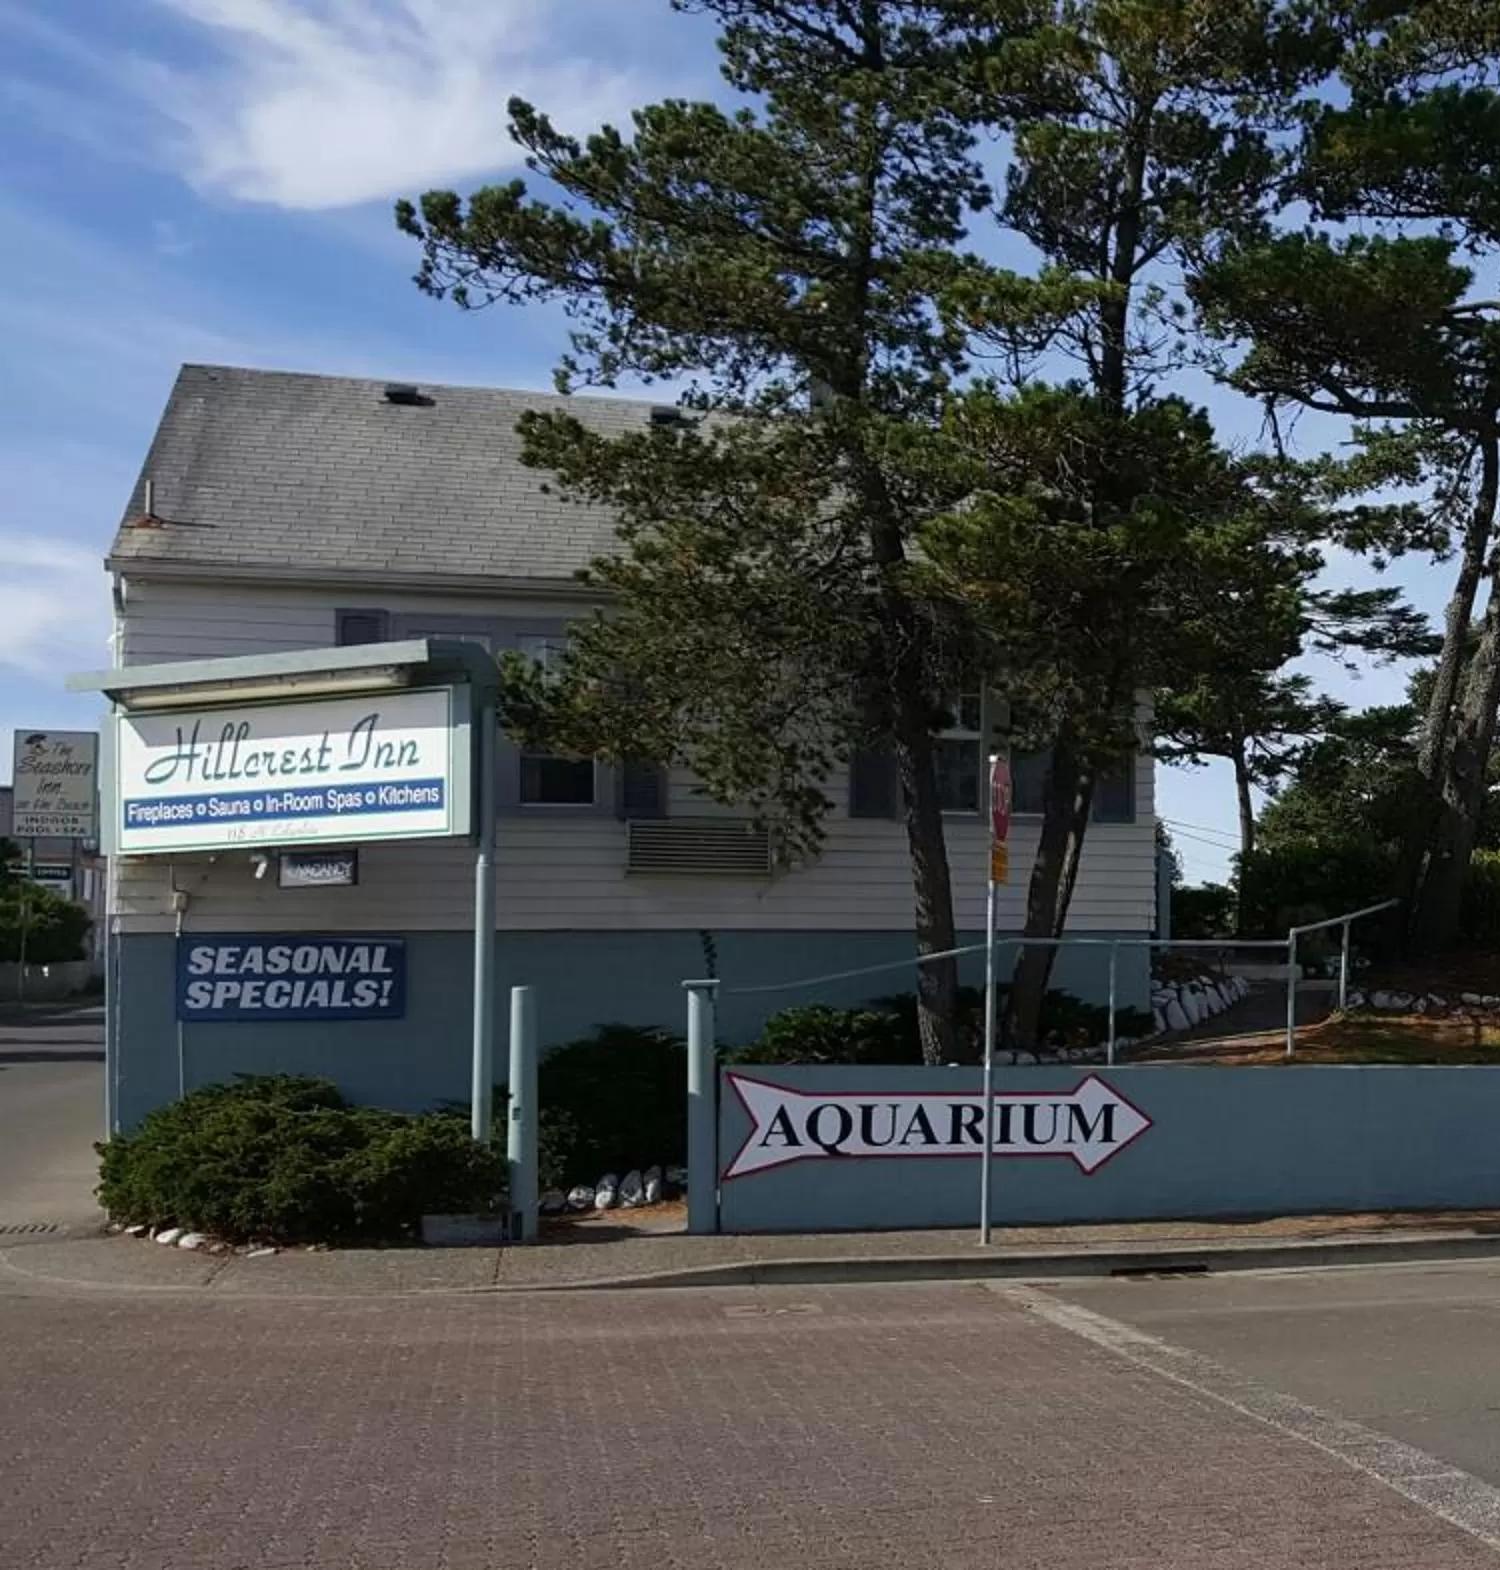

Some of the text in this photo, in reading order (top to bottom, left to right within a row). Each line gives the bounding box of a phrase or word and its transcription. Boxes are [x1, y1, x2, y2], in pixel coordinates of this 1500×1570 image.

[144, 713, 420, 785] Hillcrest Inn
[127, 784, 440, 825] Fireplaces Sauna In-Room Spas Kitchens
[187, 945, 393, 975] SEASONAL
[184, 980, 394, 1009] SPECIALS!
[758, 1103, 1120, 1157] AQUARIUM
